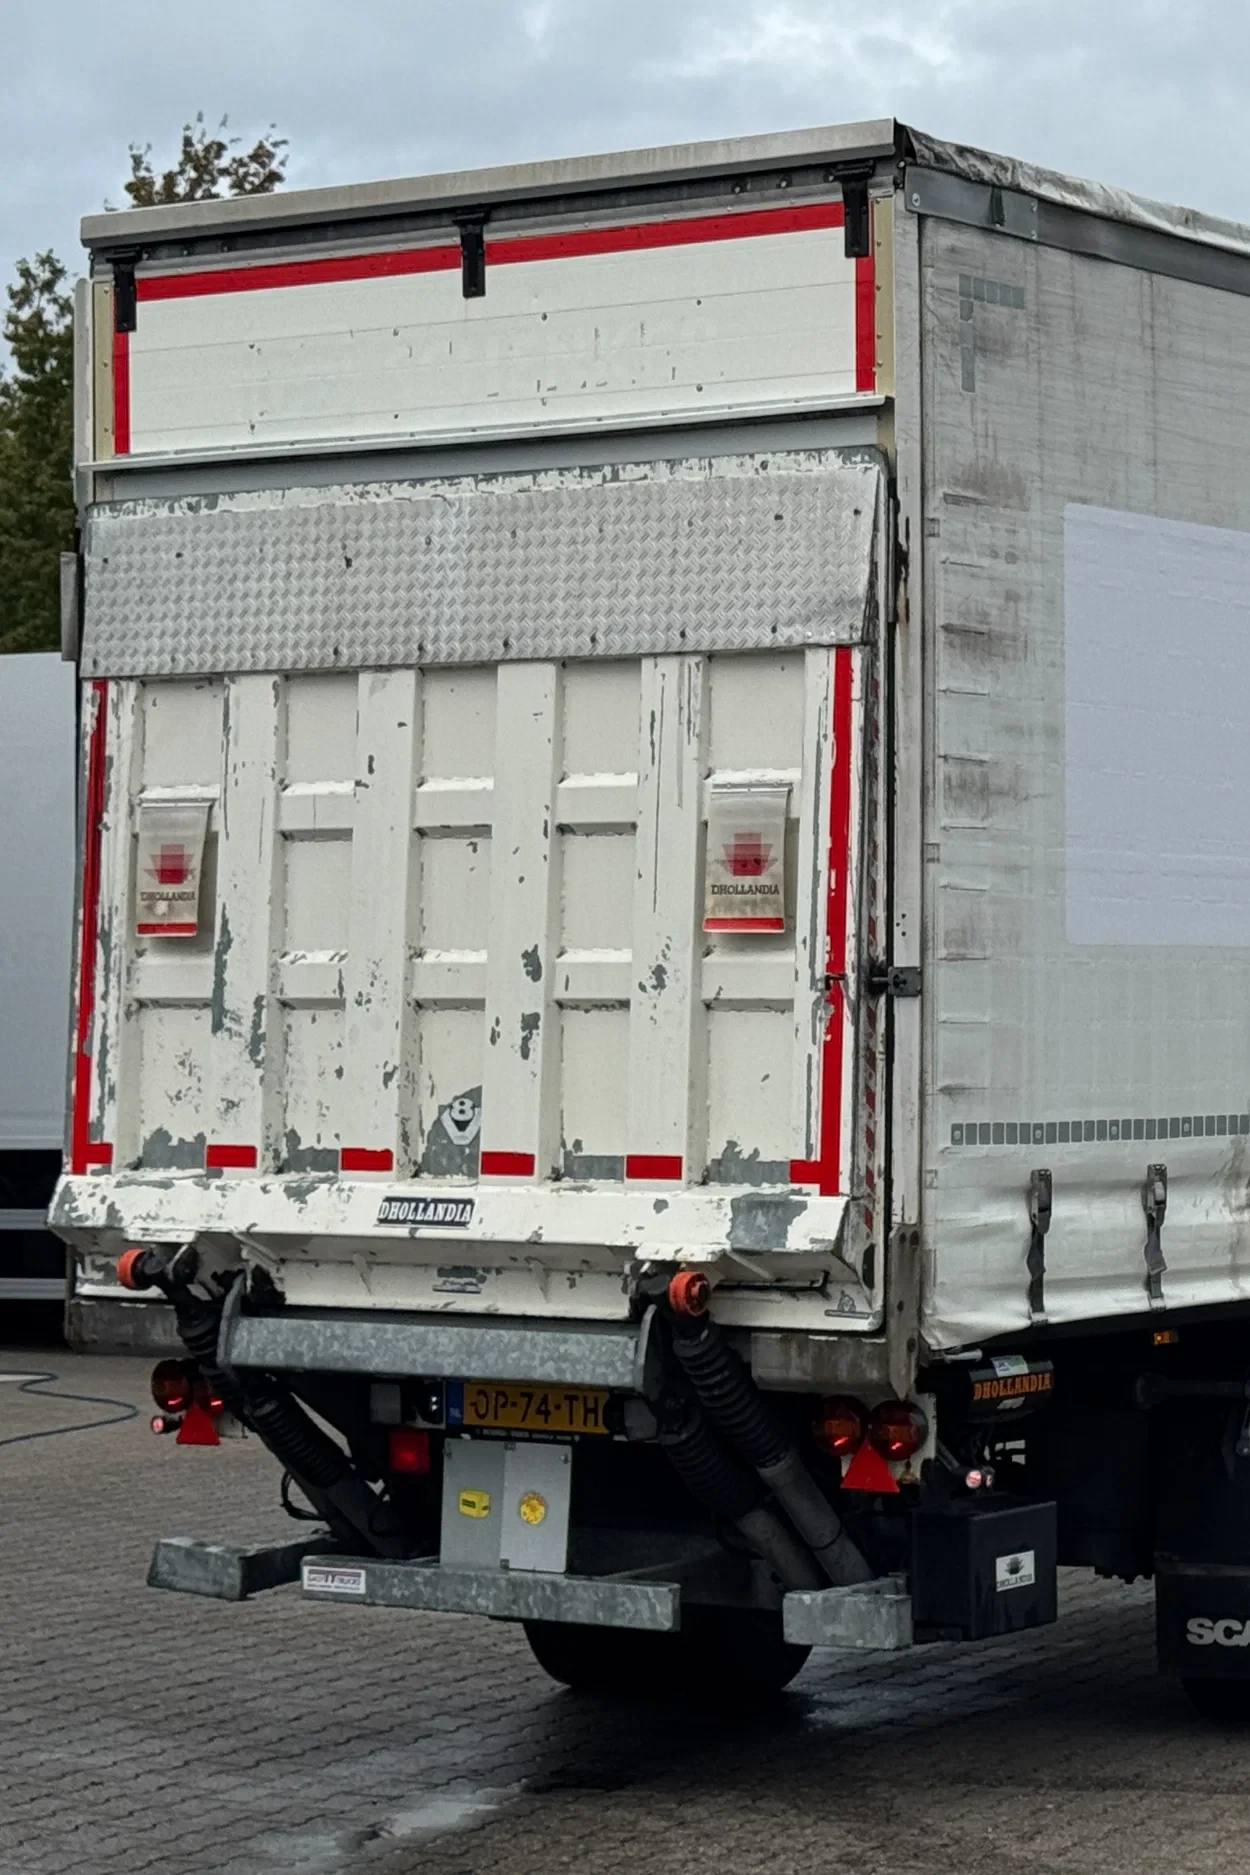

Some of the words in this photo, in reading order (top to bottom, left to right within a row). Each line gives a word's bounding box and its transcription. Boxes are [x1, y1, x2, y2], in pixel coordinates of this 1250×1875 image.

[711, 884, 779, 895] DHOLLANDIA
[378, 1201, 472, 1222] DHOLLANDIA
[973, 1373, 1051, 1400] DHOLLANDIA
